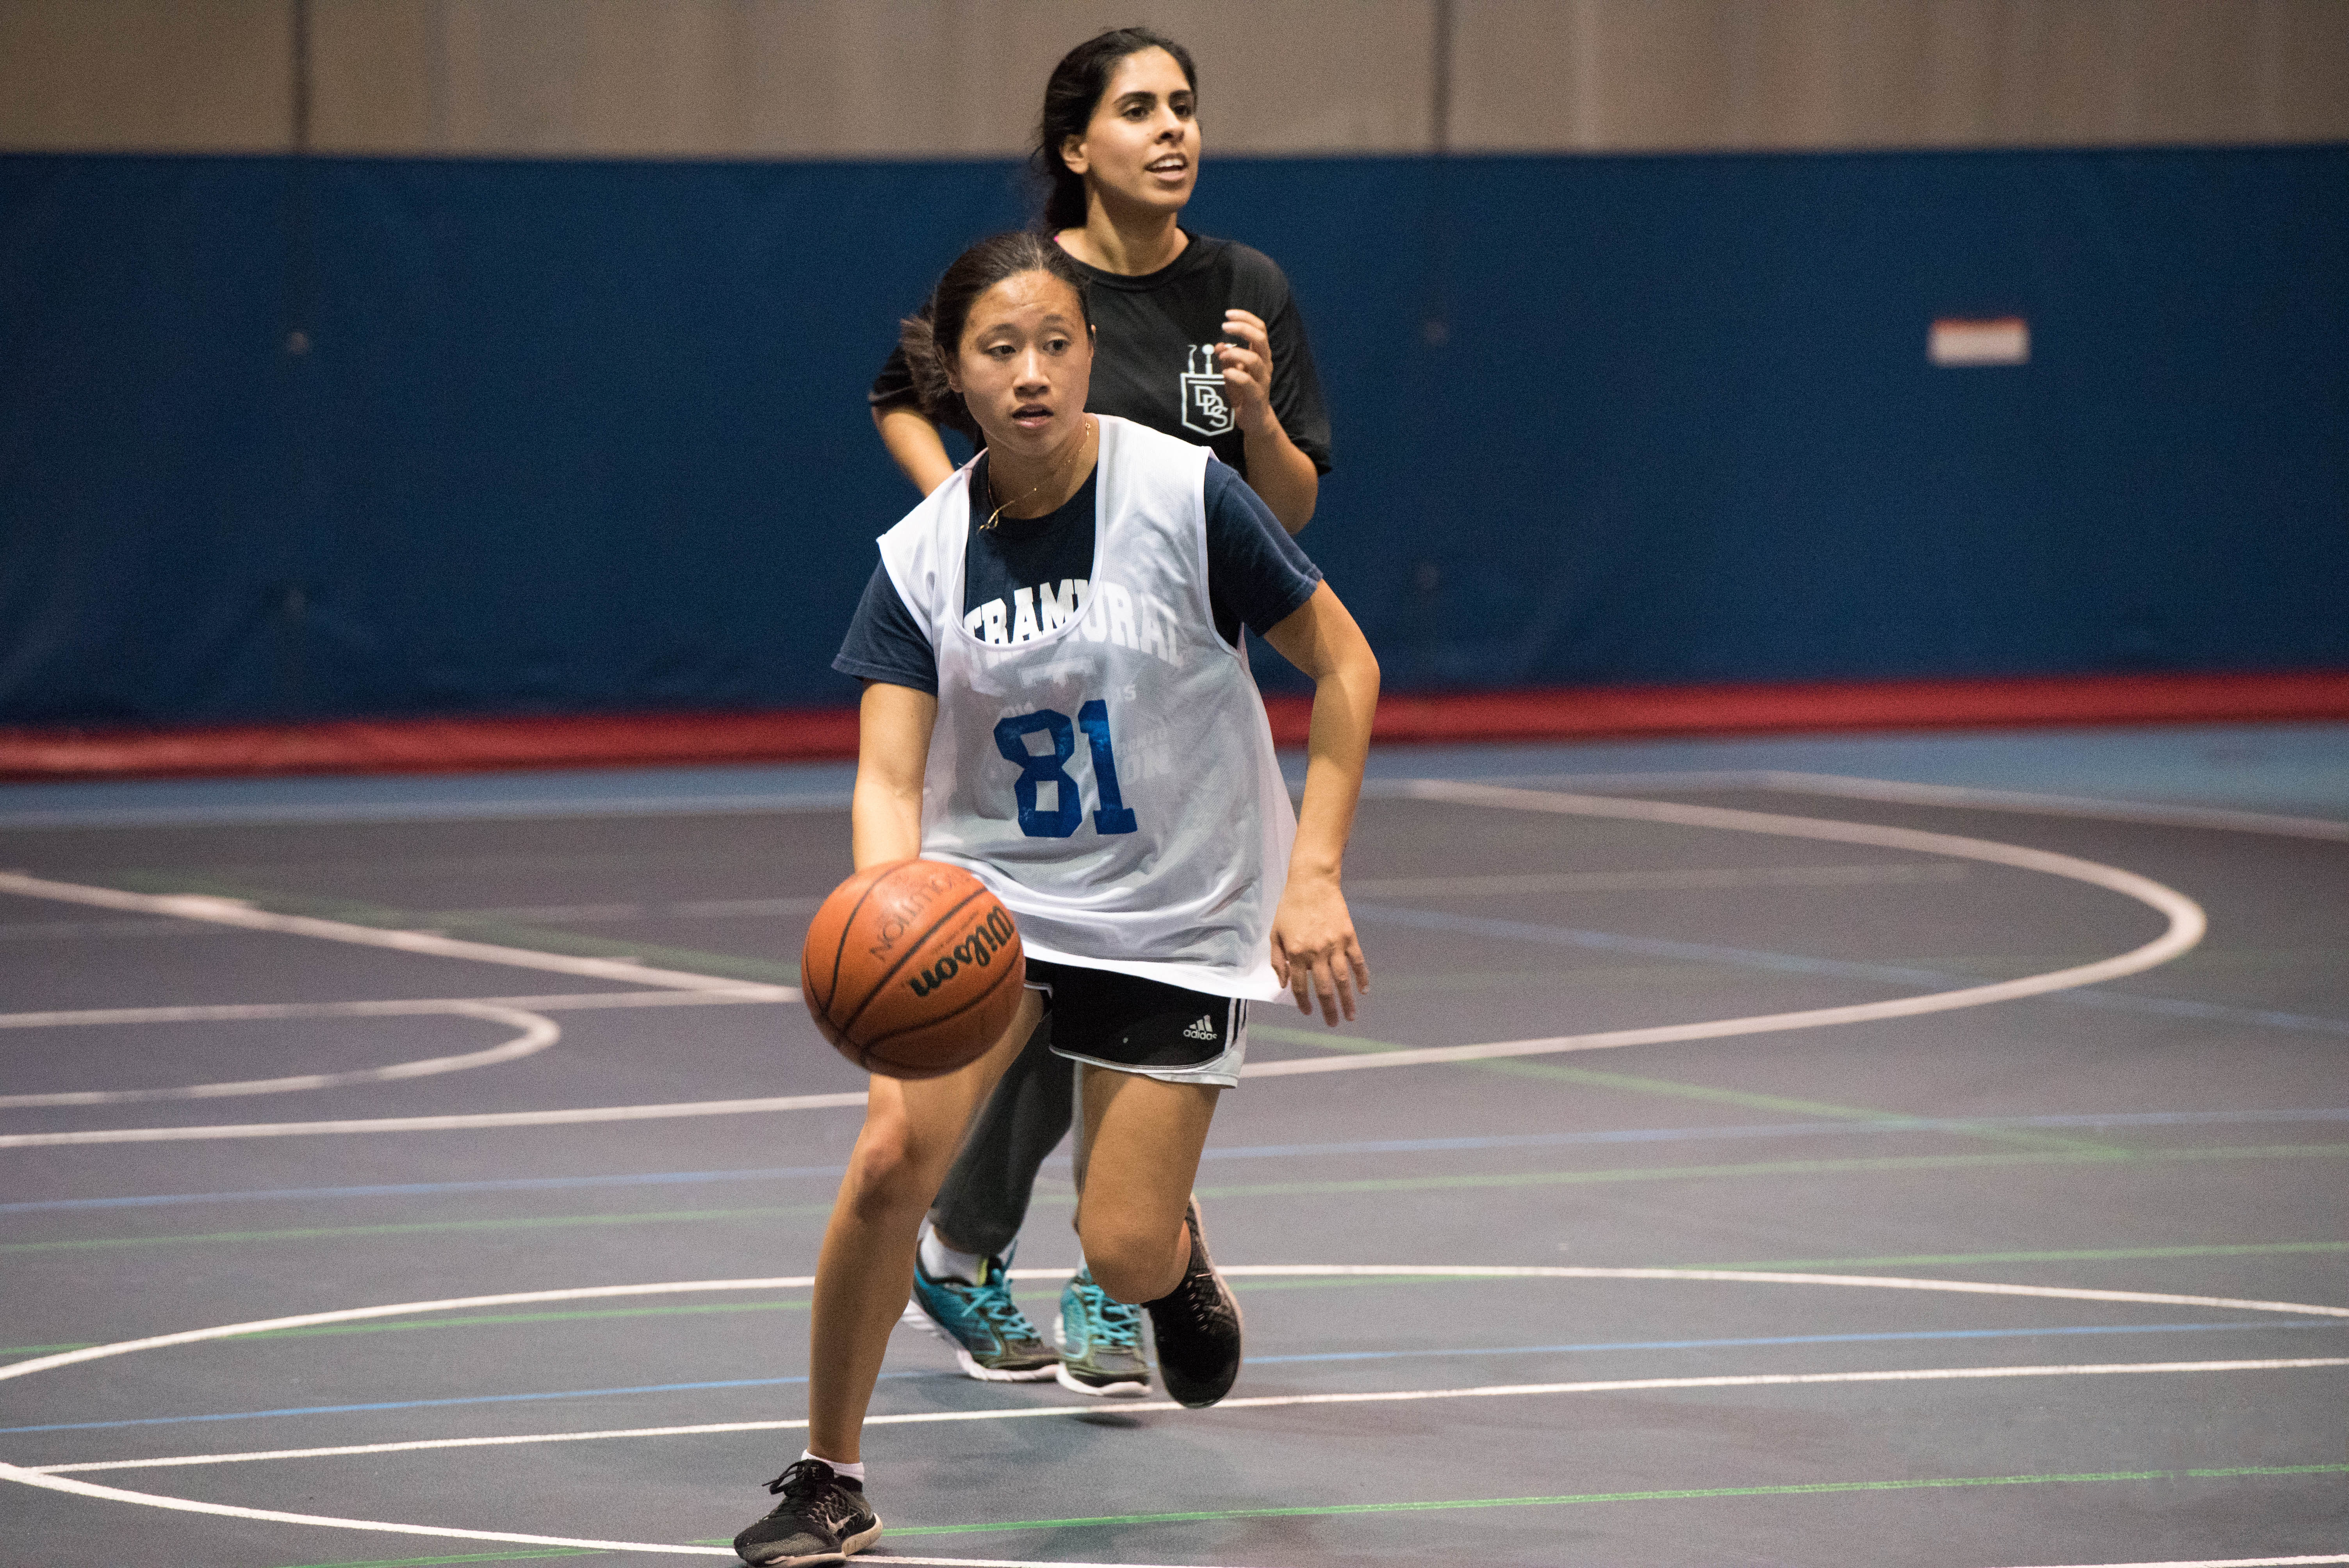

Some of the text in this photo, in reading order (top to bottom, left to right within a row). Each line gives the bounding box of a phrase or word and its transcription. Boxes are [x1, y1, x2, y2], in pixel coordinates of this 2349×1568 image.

[1194, 385, 1229, 428] DDS
[993, 699, 1138, 838] 81
[909, 906, 1015, 997] Wilson
[1183, 1029, 1218, 1041] adidas
